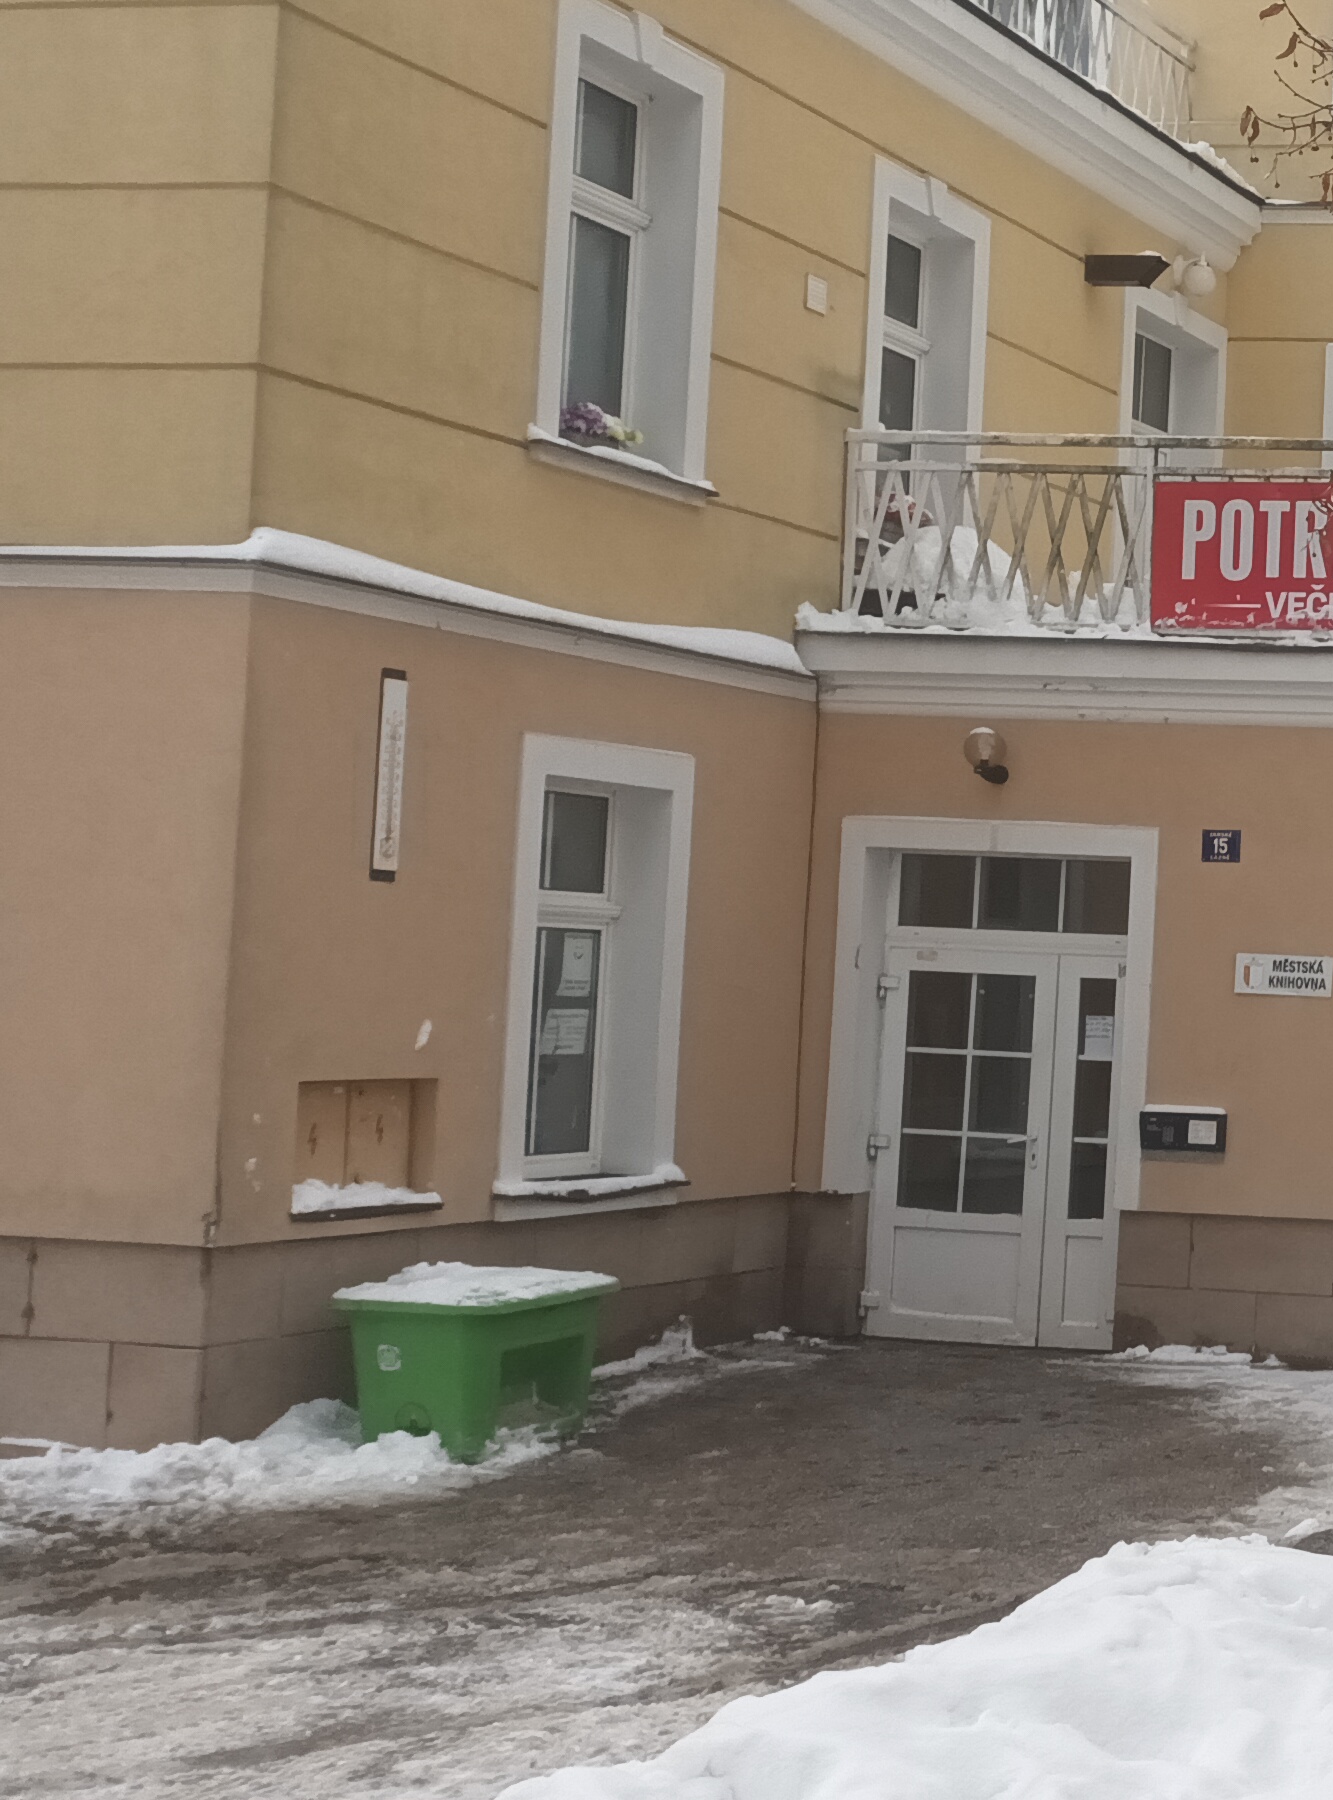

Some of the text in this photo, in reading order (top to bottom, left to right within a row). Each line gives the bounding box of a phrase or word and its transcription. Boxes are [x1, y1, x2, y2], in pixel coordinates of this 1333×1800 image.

[1213, 837, 1229, 854] 15
[1272, 958, 1324, 974] MĚSTSKÁ
[1268, 975, 1327, 991] KNIHOVNA
